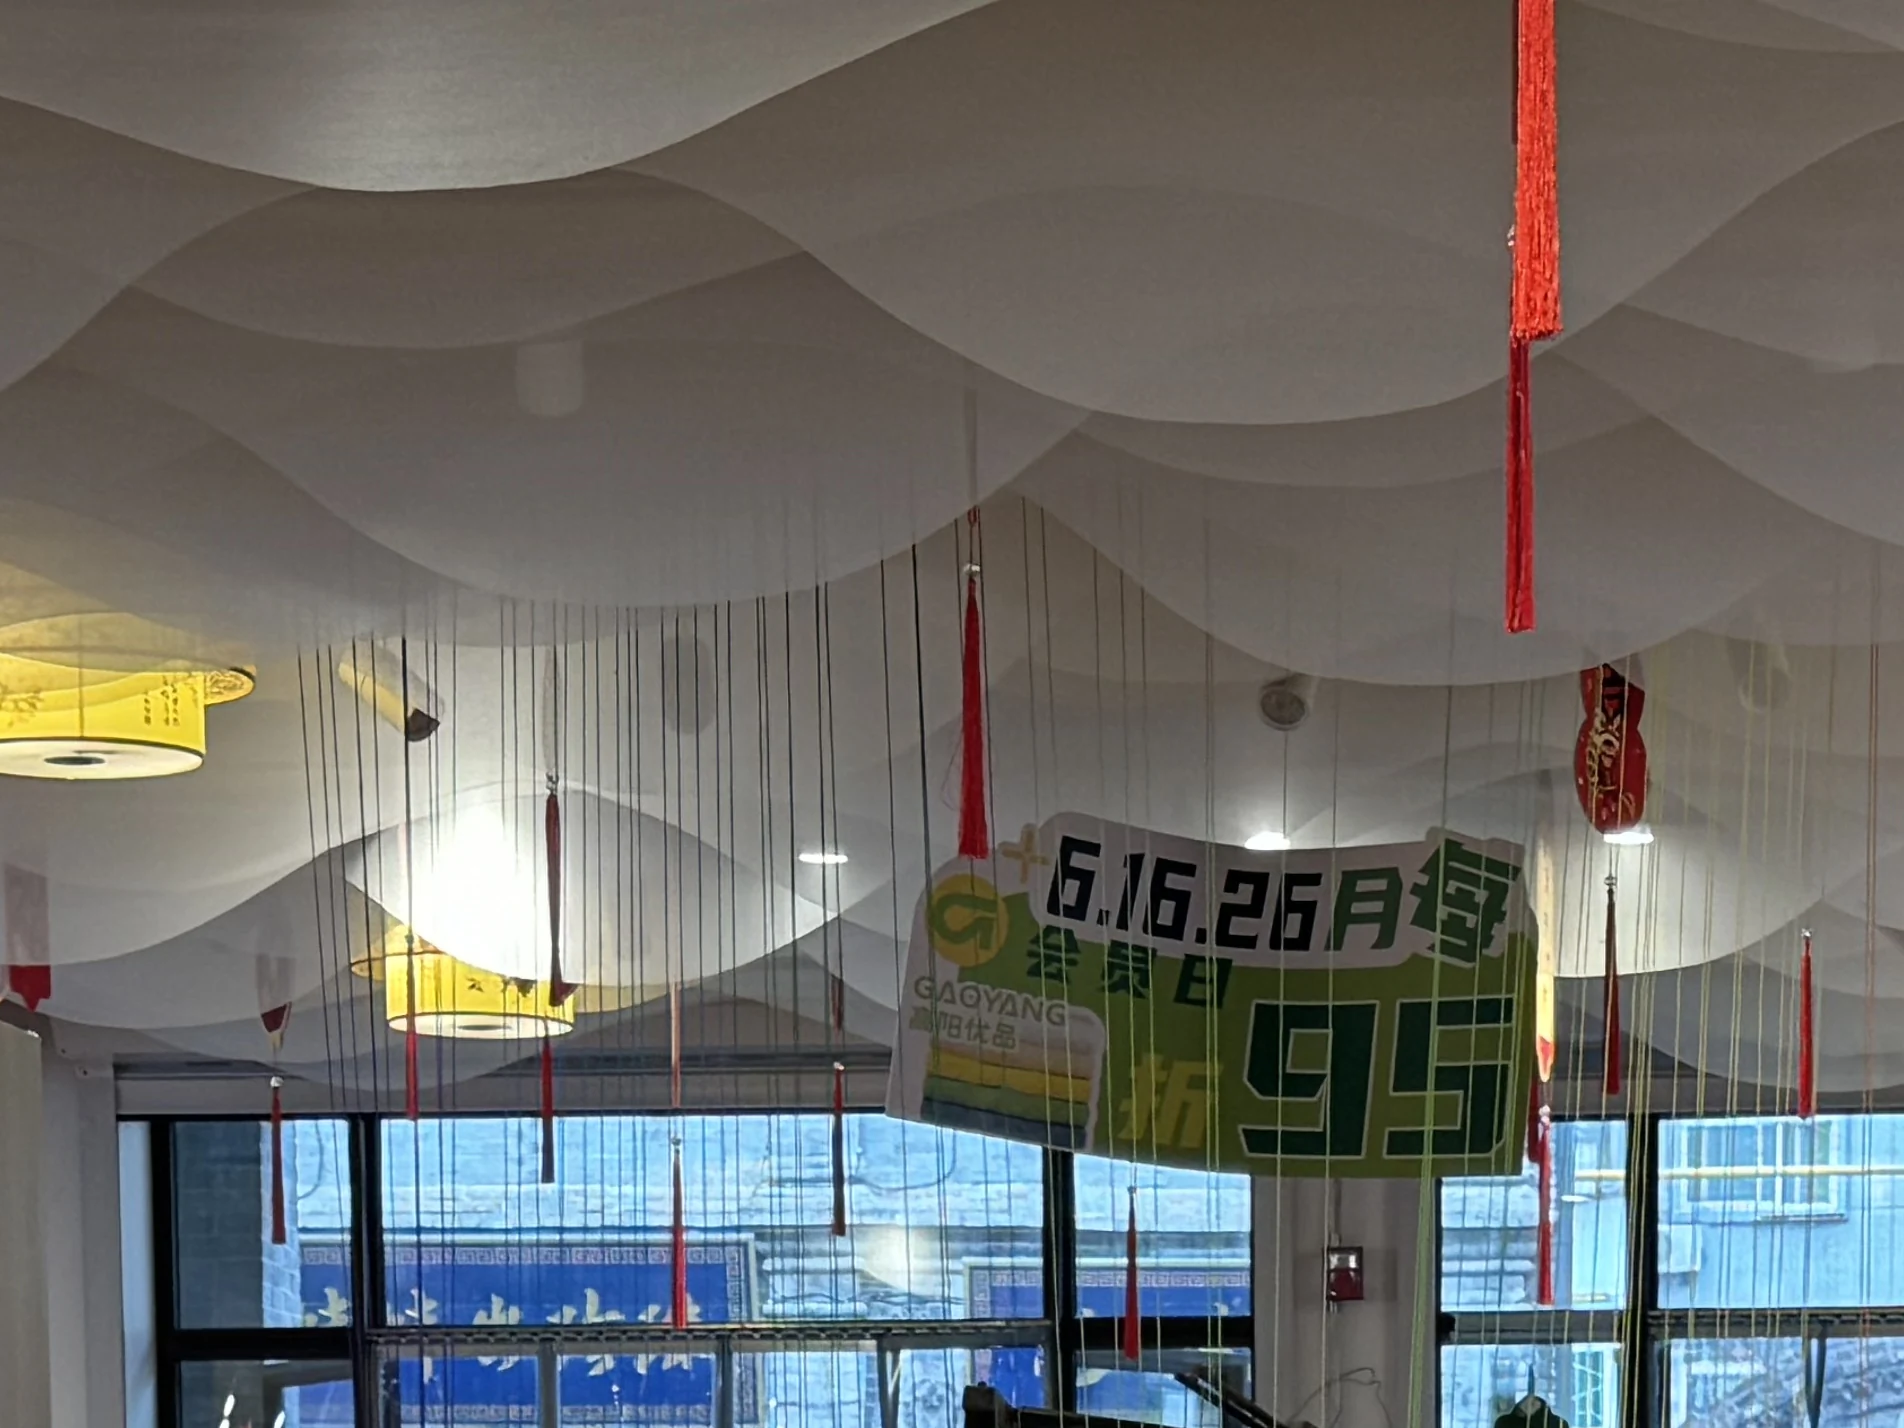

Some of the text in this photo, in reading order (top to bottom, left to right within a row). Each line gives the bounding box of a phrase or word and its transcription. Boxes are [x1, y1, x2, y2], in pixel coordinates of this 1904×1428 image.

[914, 976, 1066, 1026] GAOYANG
[1027, 924, 1233, 1008] 会员日
[1238, 995, 1515, 1159] 95
